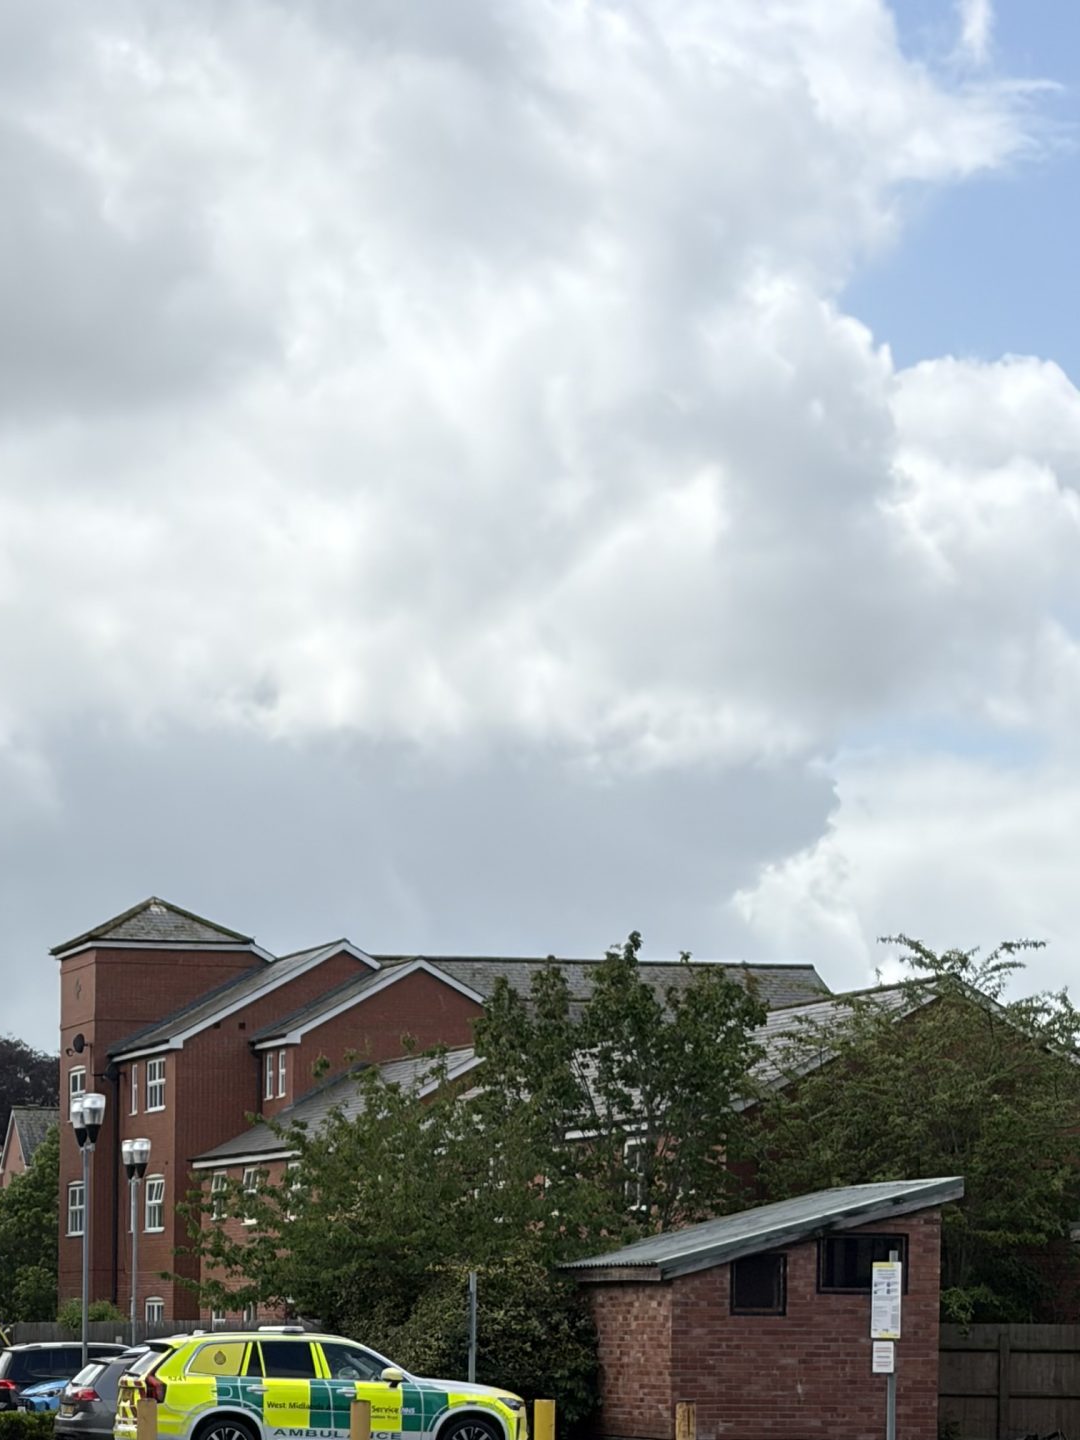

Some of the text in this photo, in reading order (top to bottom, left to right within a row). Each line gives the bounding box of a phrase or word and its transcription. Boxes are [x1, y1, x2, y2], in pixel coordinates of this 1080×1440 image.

[266, 1401, 286, 1409] West
[371, 1405, 399, 1414] Service
[273, 1428, 402, 1440] AMBULCE
